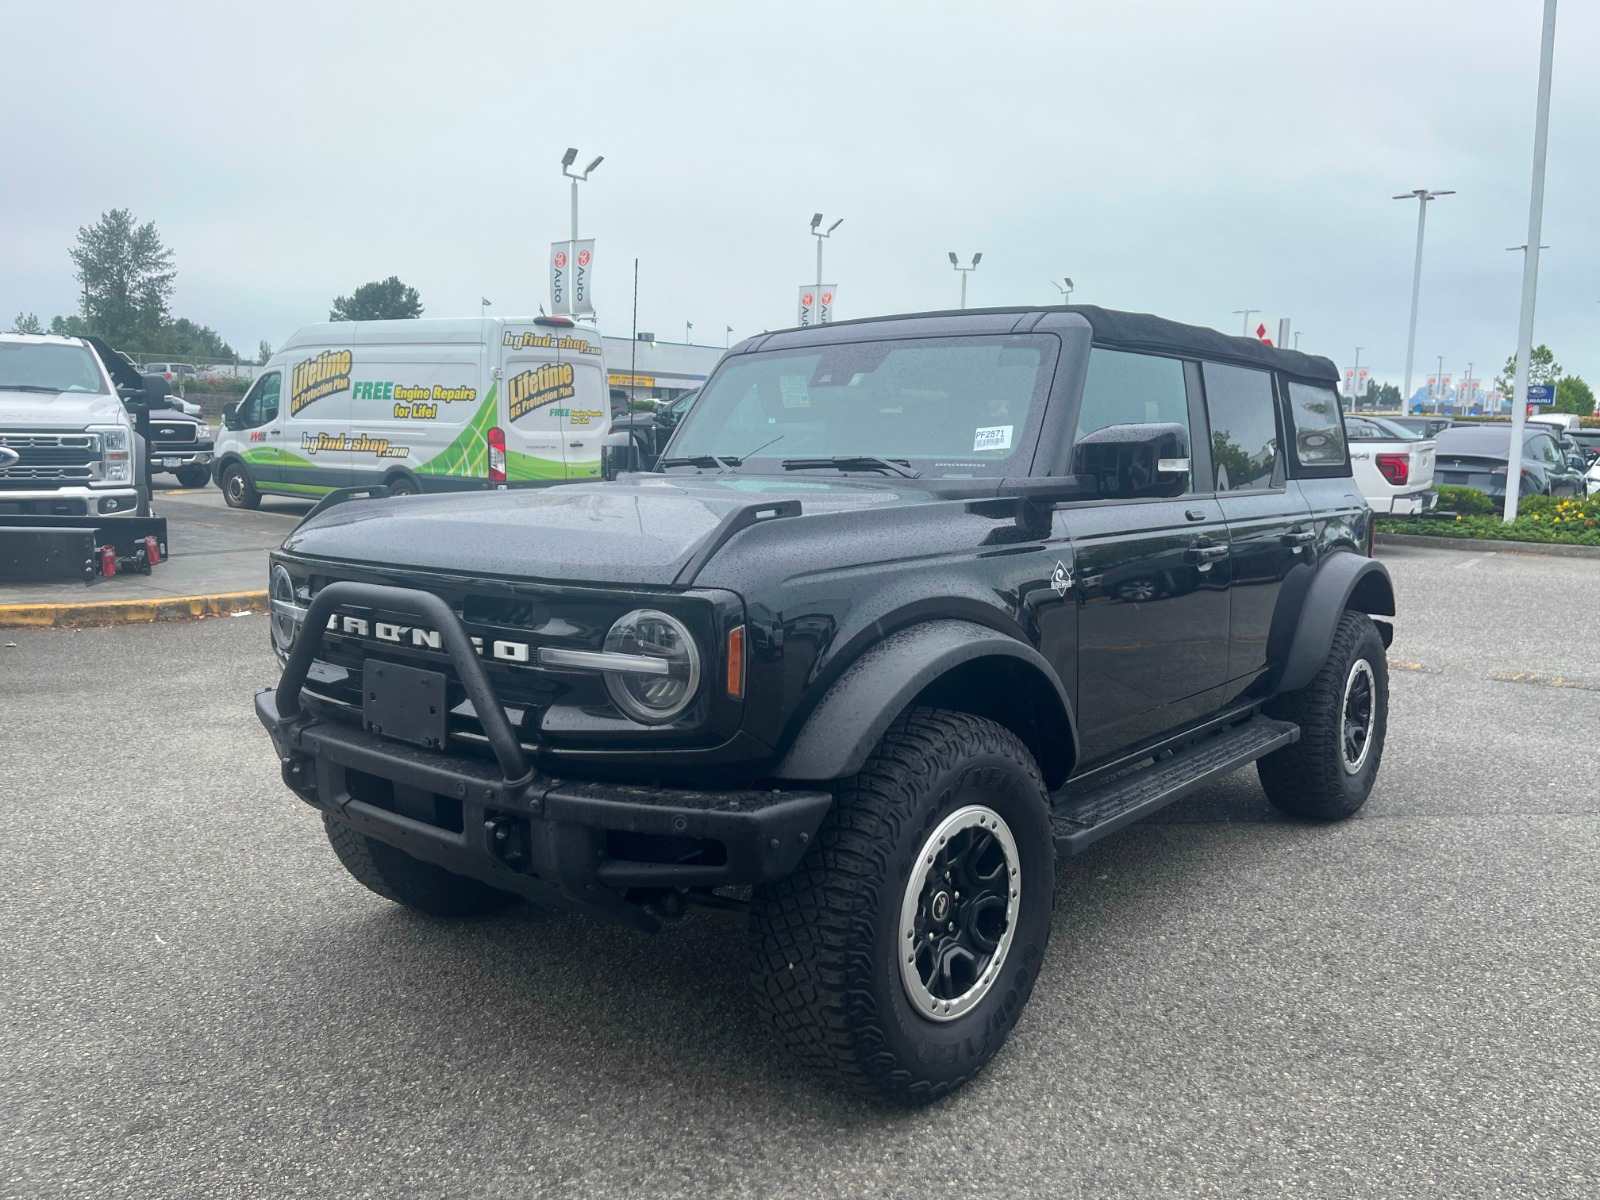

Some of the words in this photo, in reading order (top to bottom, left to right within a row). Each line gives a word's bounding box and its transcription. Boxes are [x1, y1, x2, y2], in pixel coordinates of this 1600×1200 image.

[554, 268, 563, 303] Auto
[576, 266, 585, 302] Auto
[801, 306, 809, 328] Aut
[292, 350, 352, 400] Lifetime
[509, 362, 574, 406] Lifetime
[352, 381, 393, 400] FREE
[394, 384, 431, 403] Engine
[432, 384, 476, 403] Repairs
[394, 402, 410, 418] for
[411, 402, 437, 419] Life!
[549, 408, 570, 416] FREE
[301, 431, 410, 458] bgfindashop.com
